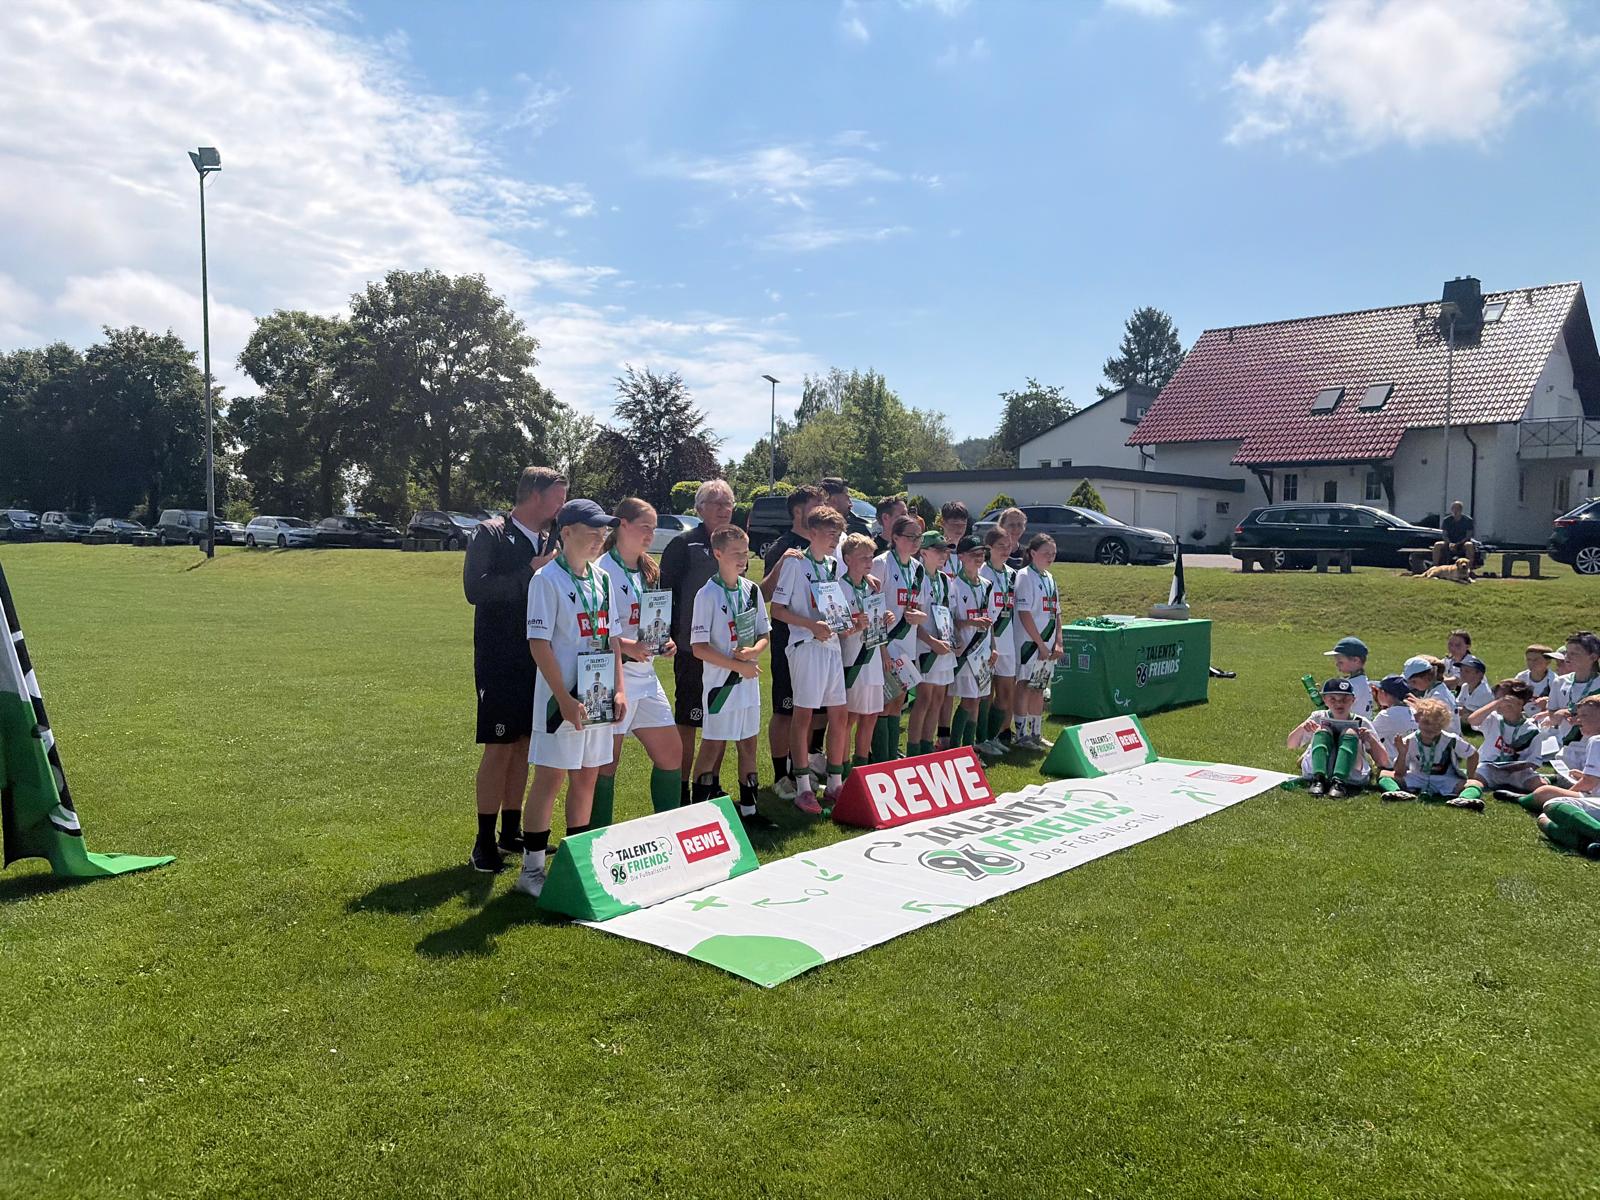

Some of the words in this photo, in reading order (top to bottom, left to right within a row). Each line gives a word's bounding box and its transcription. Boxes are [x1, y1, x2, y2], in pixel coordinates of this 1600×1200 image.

[1146, 643, 1176, 660] TALENTS
[1136, 664, 1148, 687] 96
[1148, 659, 1180, 678] FRIENDS
[1118, 733, 1140, 746] REWE
[865, 756, 990, 821] REWE
[904, 788, 1067, 847] TALENTS
[616, 841, 658, 861] TALENTS
[682, 830, 725, 855] REWE
[921, 845, 1021, 880] 96
[979, 800, 1135, 851] FRIENDS
[1029, 846, 1067, 861] Die
[611, 864, 627, 884] 96
[627, 852, 669, 874] FRIENDS
